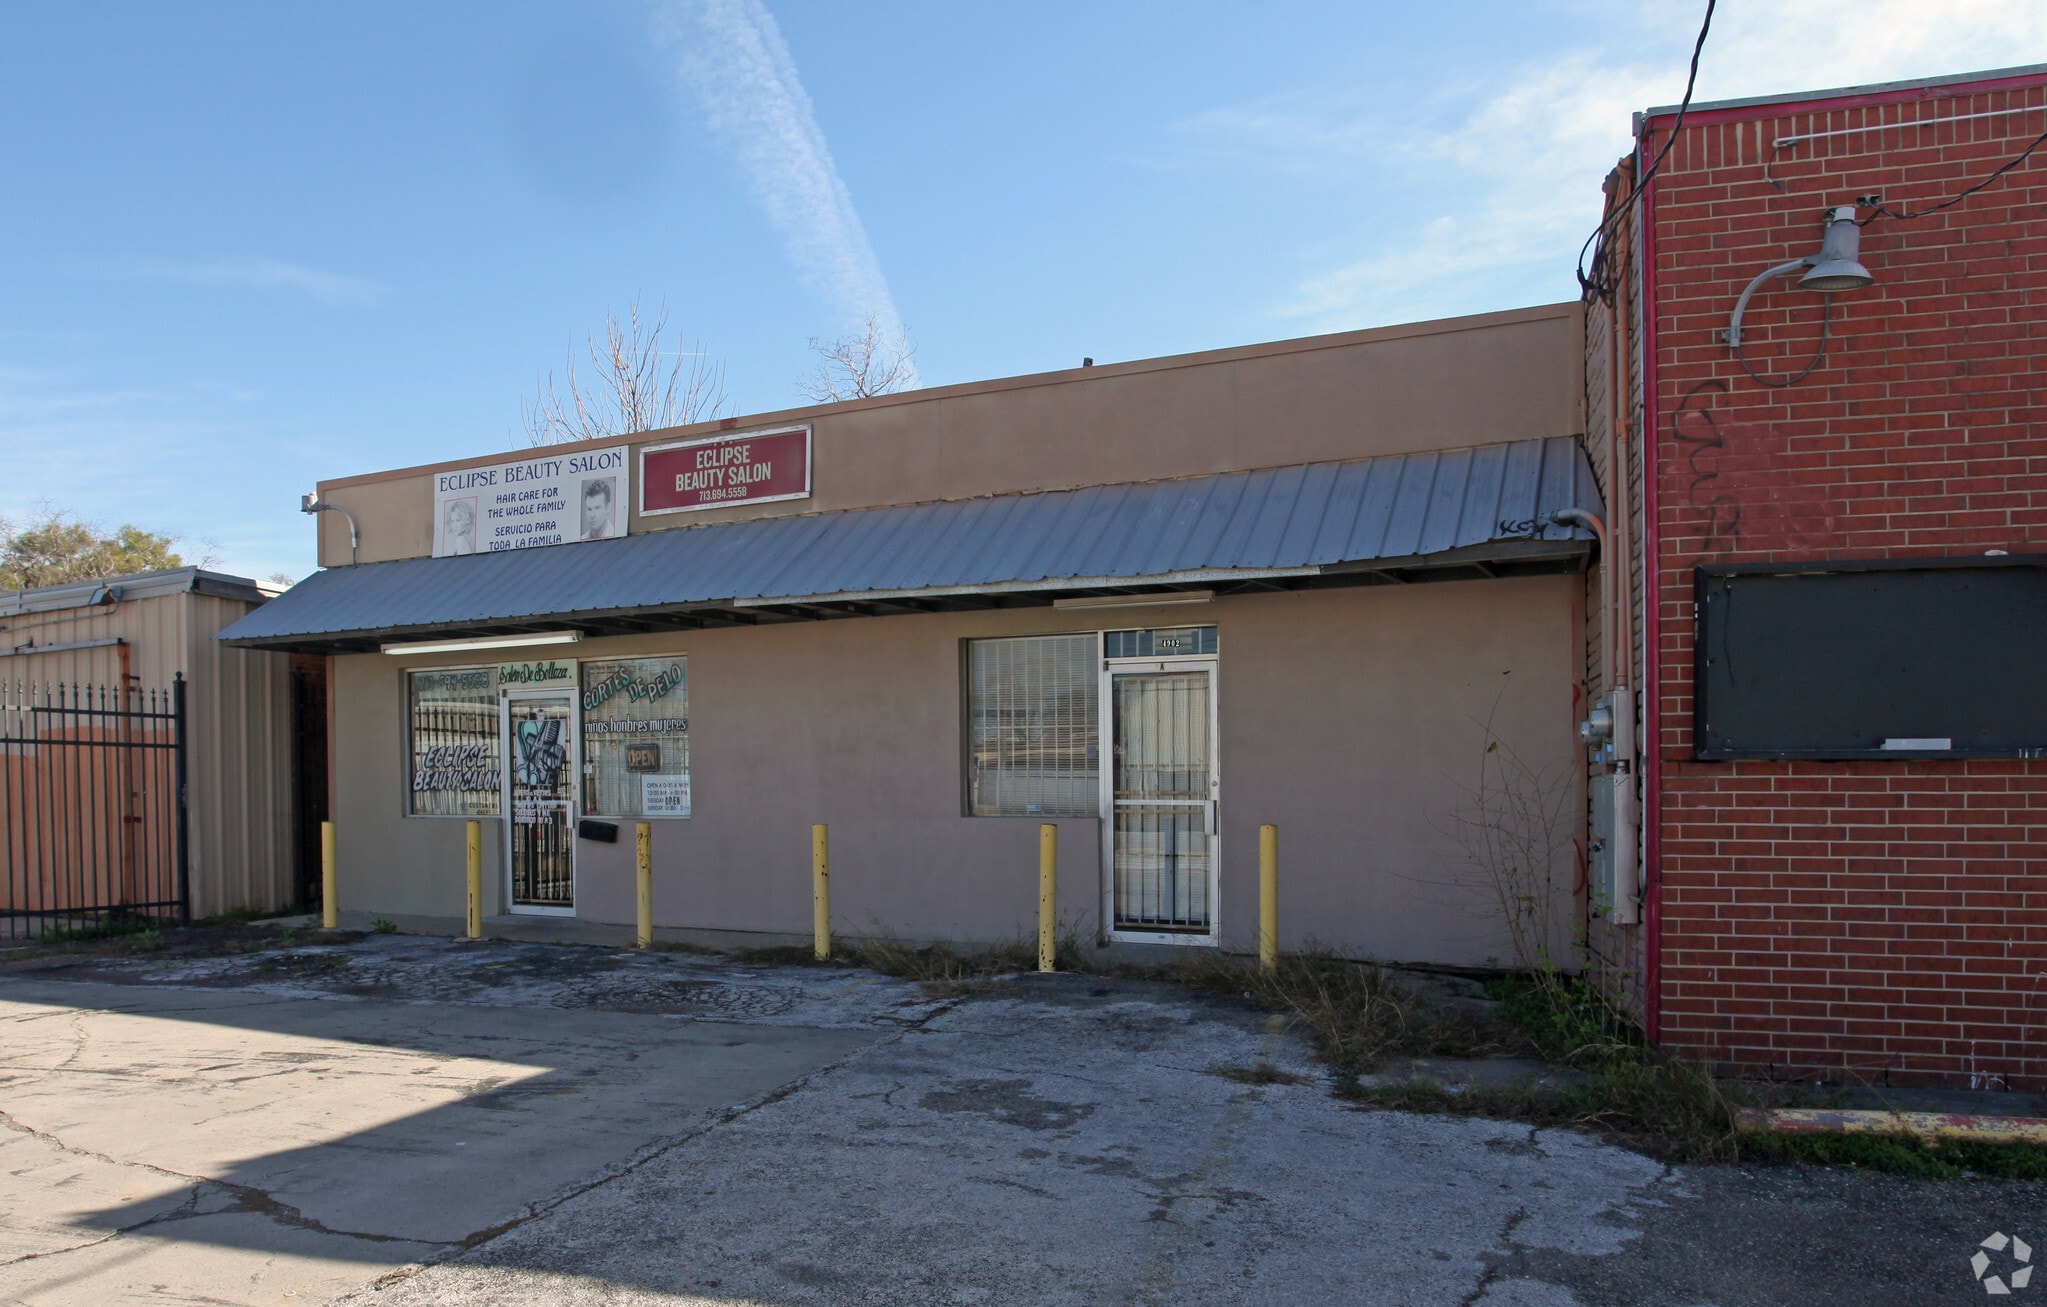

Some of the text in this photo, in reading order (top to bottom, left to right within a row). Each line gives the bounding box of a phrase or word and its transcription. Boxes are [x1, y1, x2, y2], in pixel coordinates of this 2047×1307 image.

[696, 445, 750, 469] ECLIPSE
[440, 451, 622, 492] ECLIPSE BEAUTY SALON
[675, 462, 771, 492] BEAUTY SALON
[496, 487, 558, 504] HAIR CARE FOR
[699, 486, 747, 502] 713.694.5558
[488, 500, 566, 519] THE WHOLE FAMILY
[495, 521, 556, 537] SERVICIO PARA
[489, 534, 562, 551] TODA LA FAMILIA
[1162, 639, 1181, 648] 4902
[1160, 663, 1165, 671] A
[583, 663, 683, 711] CORTES DE PELO
[650, 718, 688, 735] mujeres
[424, 744, 489, 768] ECLIPSE
[628, 750, 655, 767] OPEN
[413, 769, 501, 793] BEAUTY SALON
